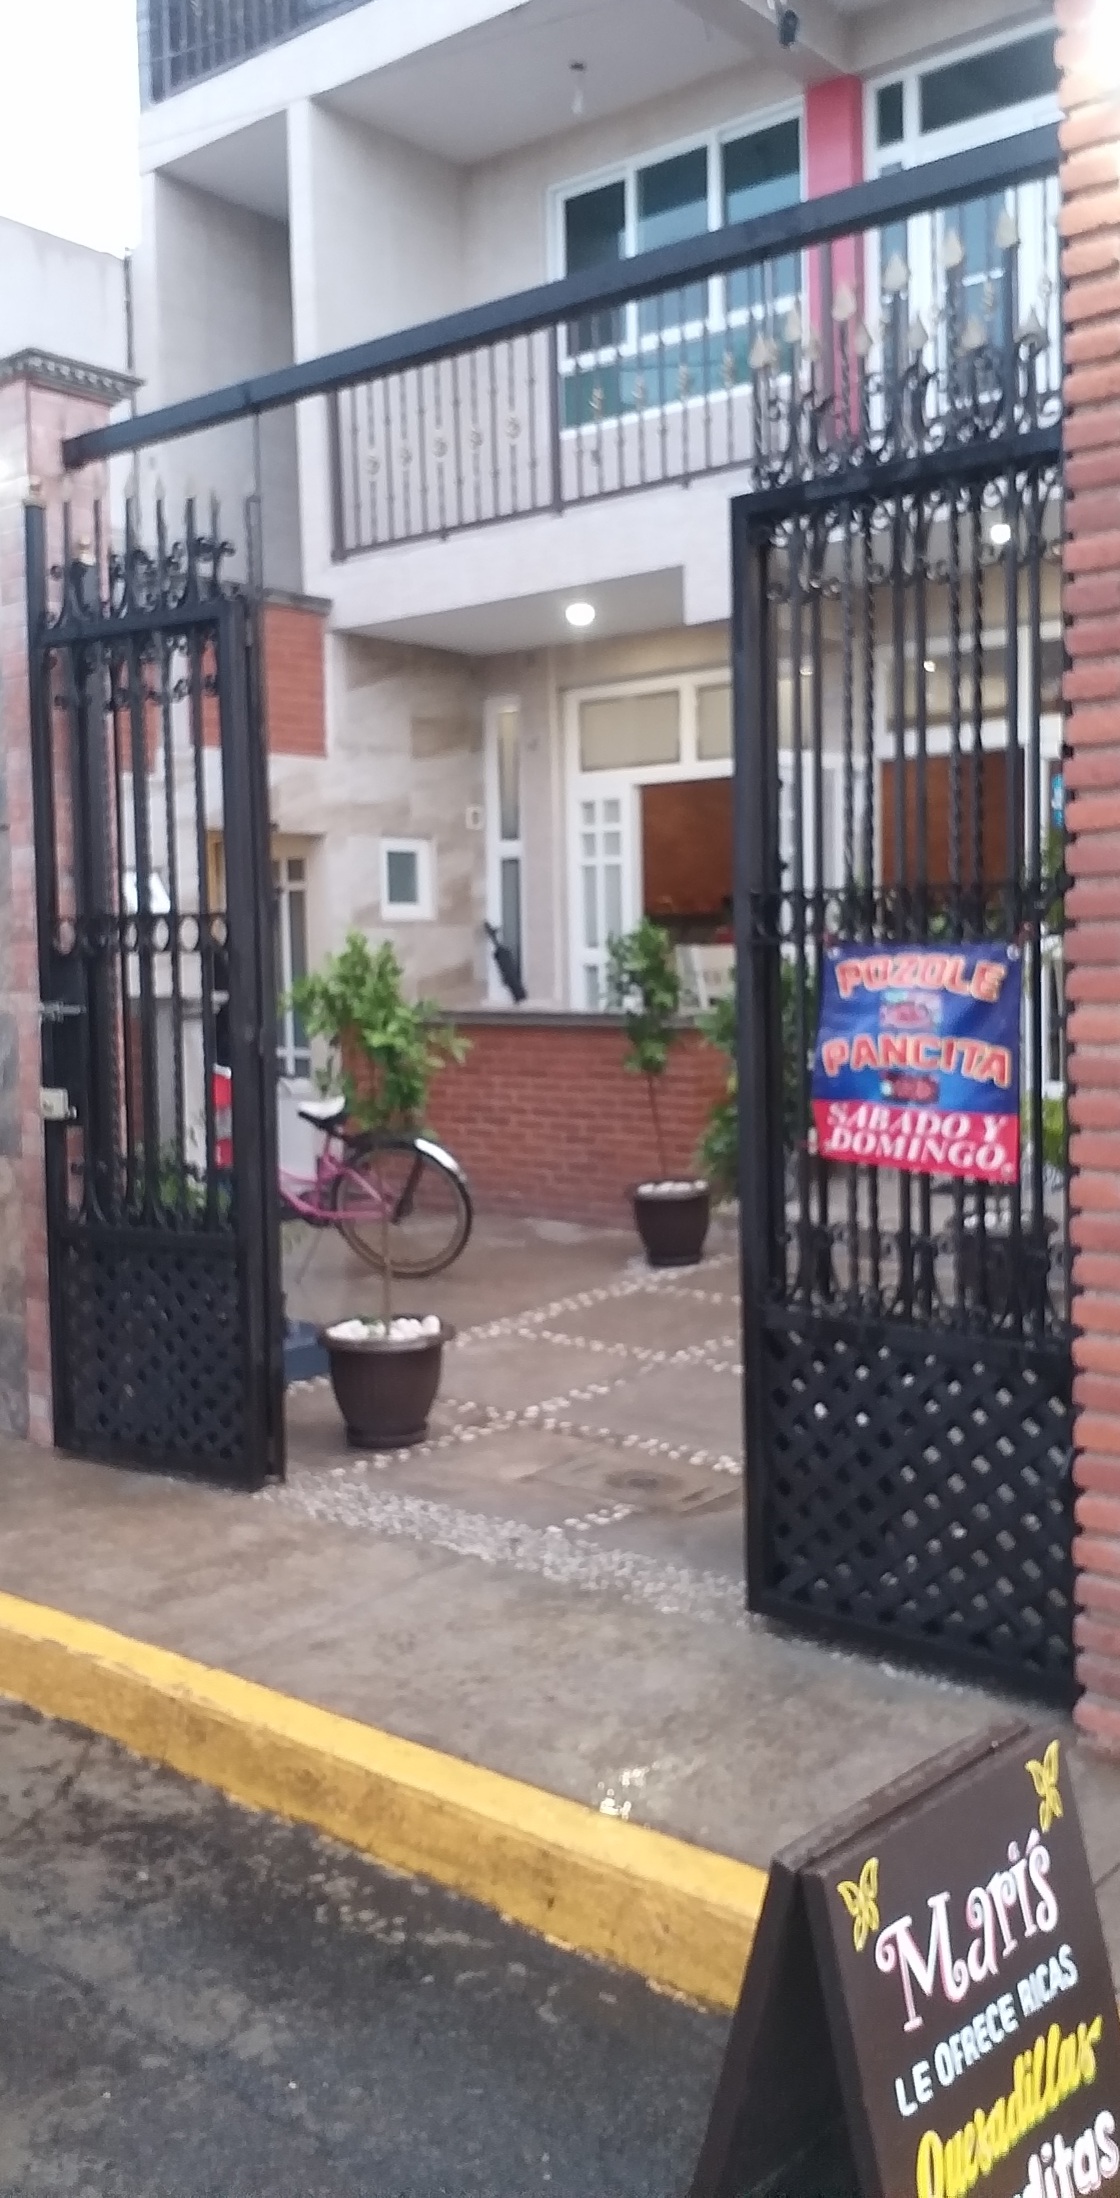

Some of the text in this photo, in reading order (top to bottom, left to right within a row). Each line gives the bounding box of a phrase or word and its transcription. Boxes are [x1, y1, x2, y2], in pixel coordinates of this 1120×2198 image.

[836, 953, 1008, 1002] POZOLE
[821, 1034, 1012, 1089] PANCITA
[827, 1101, 1006, 1143] SABADO Y
[895, 1943, 1079, 2117] LE OFRECE RICAS
[916, 2013, 1103, 2198] Quesadillas
[1012, 2110, 1120, 2198] ditas
